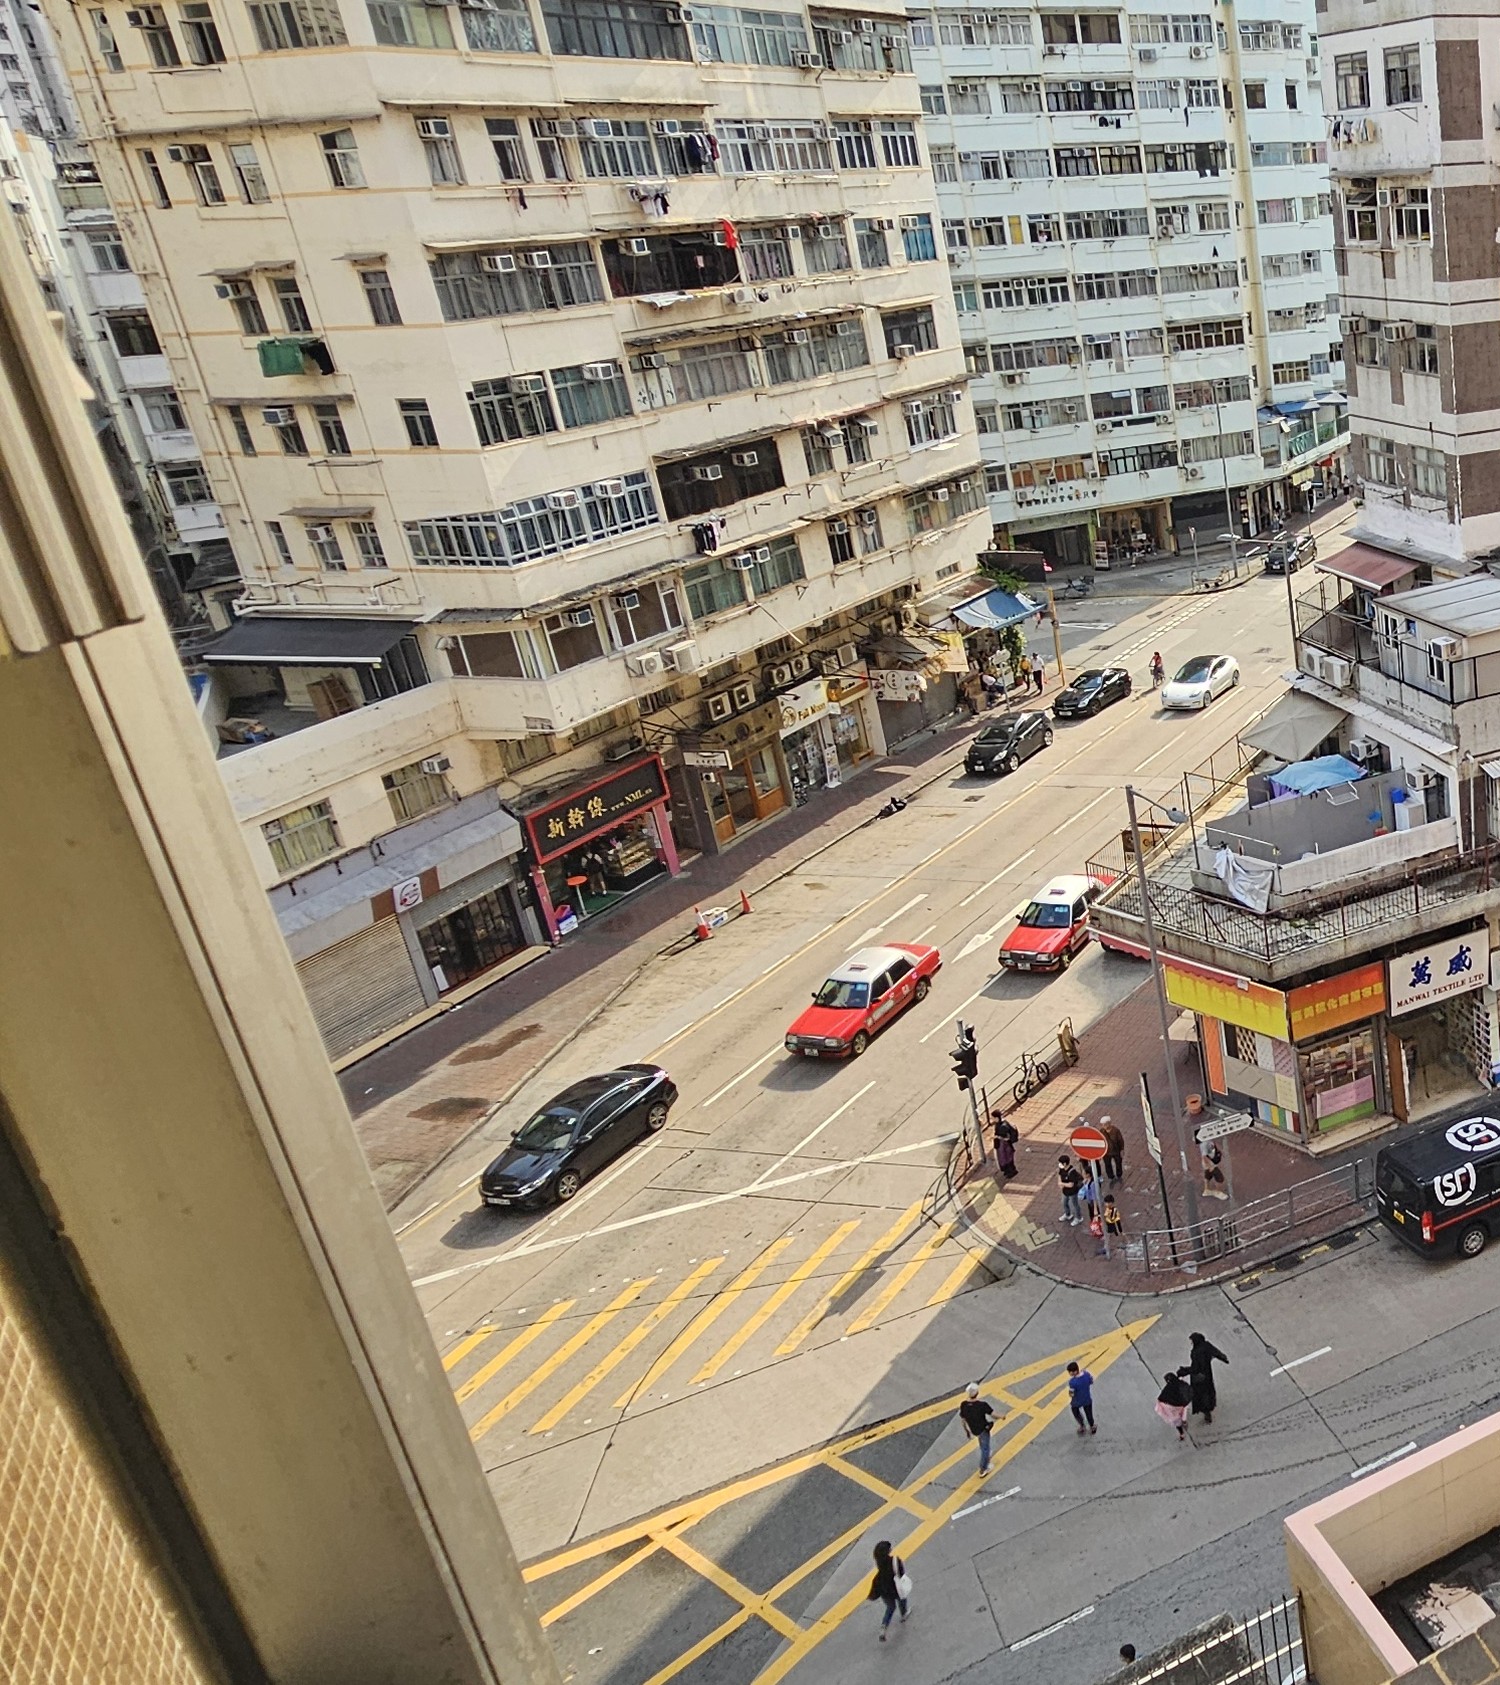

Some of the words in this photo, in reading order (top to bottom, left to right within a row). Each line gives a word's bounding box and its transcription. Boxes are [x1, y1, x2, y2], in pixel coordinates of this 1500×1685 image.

[547, 796, 607, 839] 新幹線
[1408, 944, 1473, 988] 萬威
[1396, 990, 1430, 1008] MANWAI
[1432, 979, 1466, 996] TEXTILE
[1468, 972, 1485, 984] LTD
